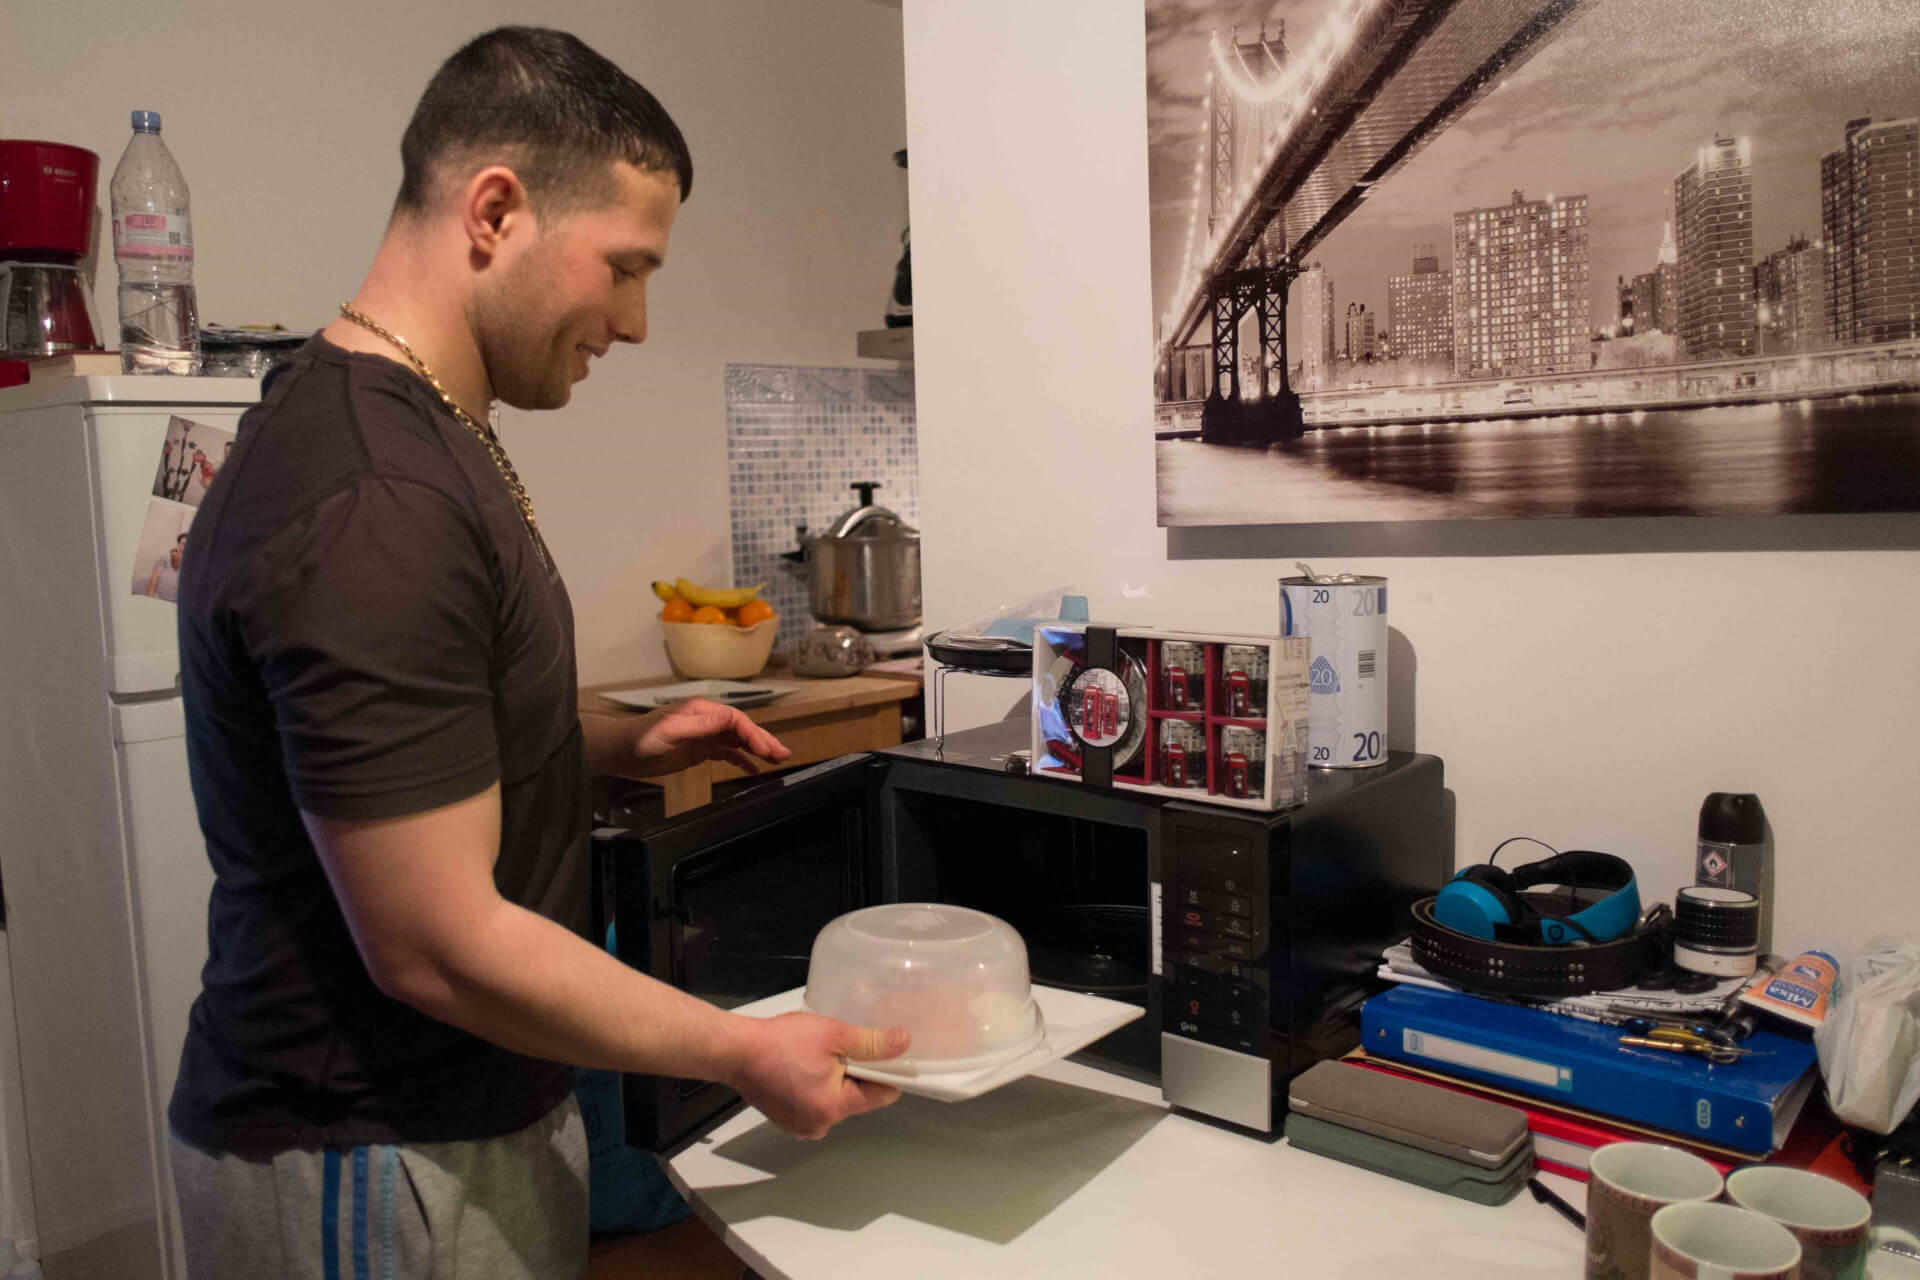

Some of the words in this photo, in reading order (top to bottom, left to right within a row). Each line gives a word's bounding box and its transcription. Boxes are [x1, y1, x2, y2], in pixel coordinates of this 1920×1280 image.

[1312, 589, 1330, 604] 20
[1352, 588, 1375, 616] 20
[1311, 669, 1332, 686] 20
[1313, 746, 1330, 761] 20
[1352, 731, 1381, 762] 20
[1769, 986, 1812, 1008] Mixa
